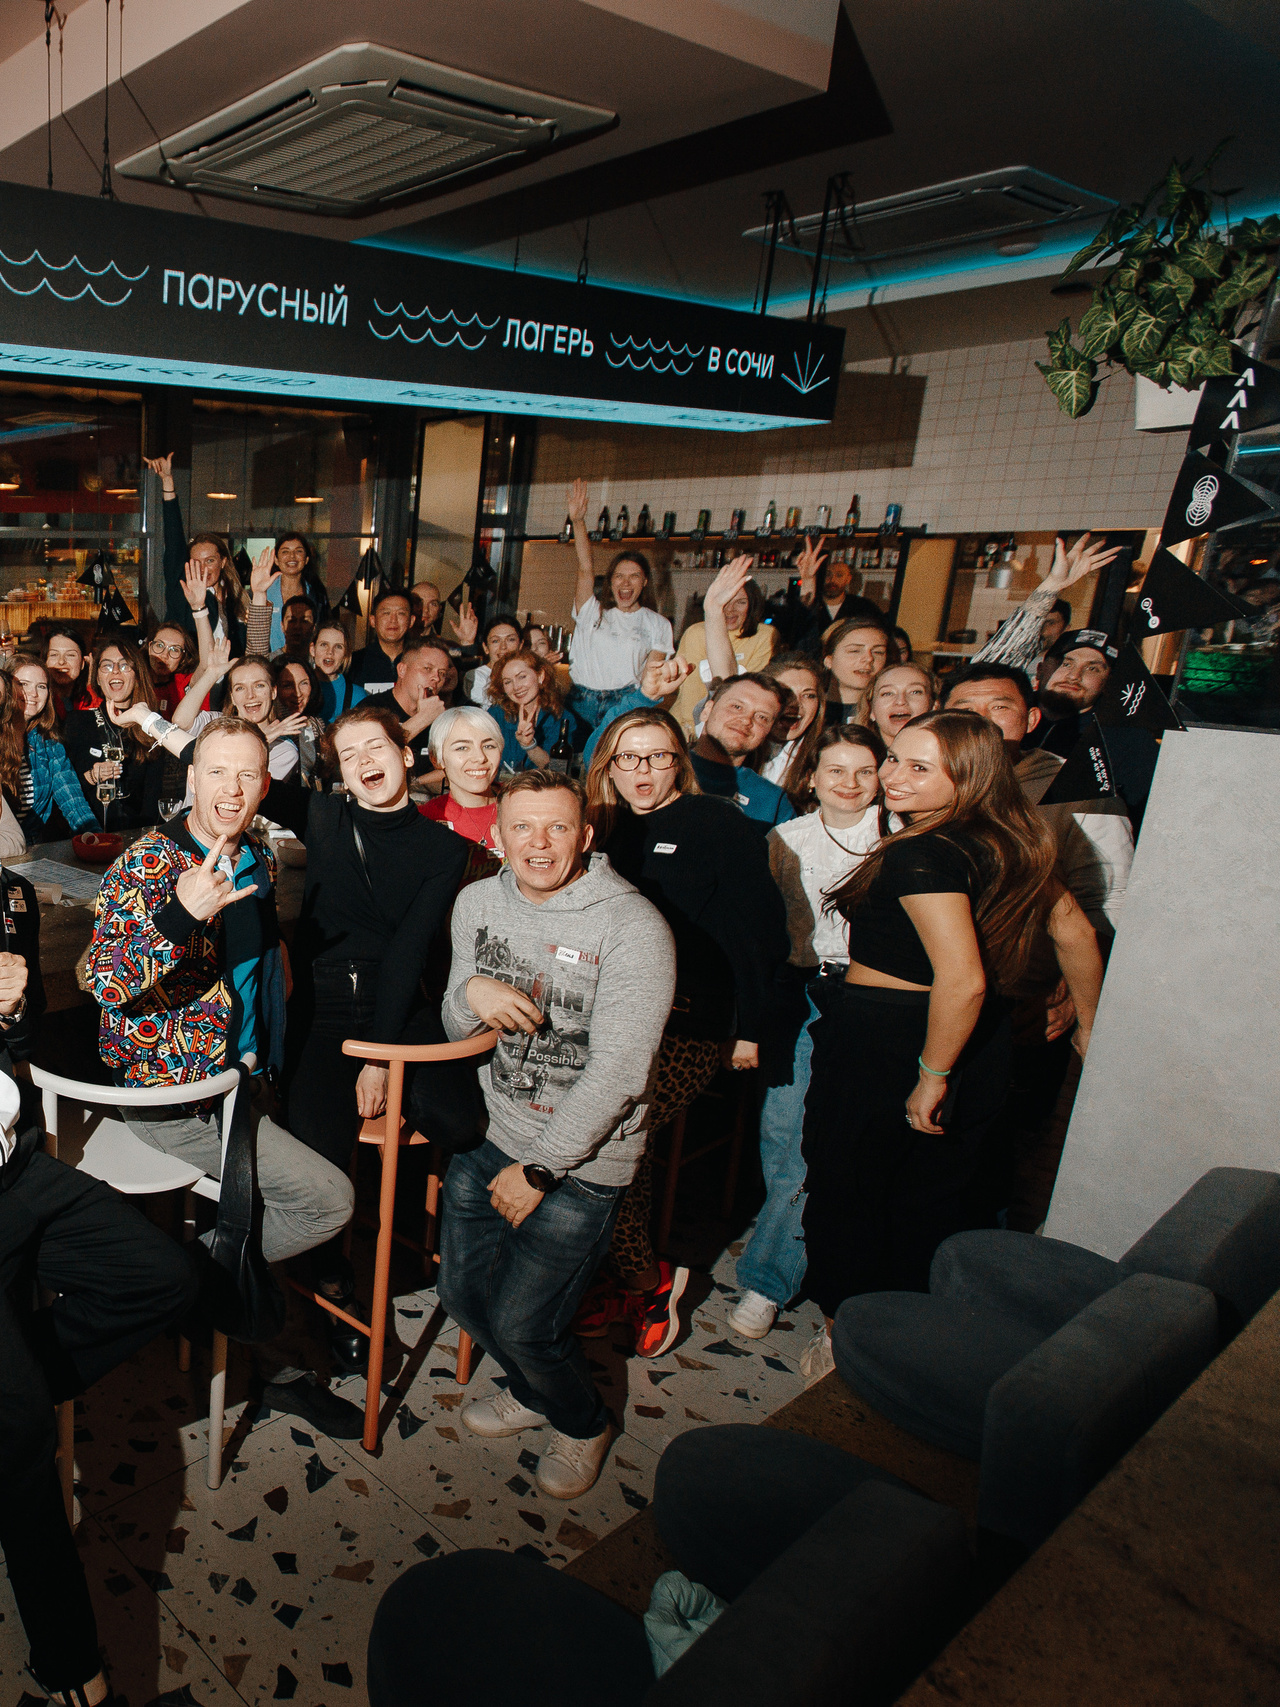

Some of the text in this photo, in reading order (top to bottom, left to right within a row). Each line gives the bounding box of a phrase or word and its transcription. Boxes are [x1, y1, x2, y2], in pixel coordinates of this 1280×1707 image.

[707, 345, 722, 373] В
[724, 347, 775, 379] СОЧИ
[527, 1048, 583, 1067] Possible
